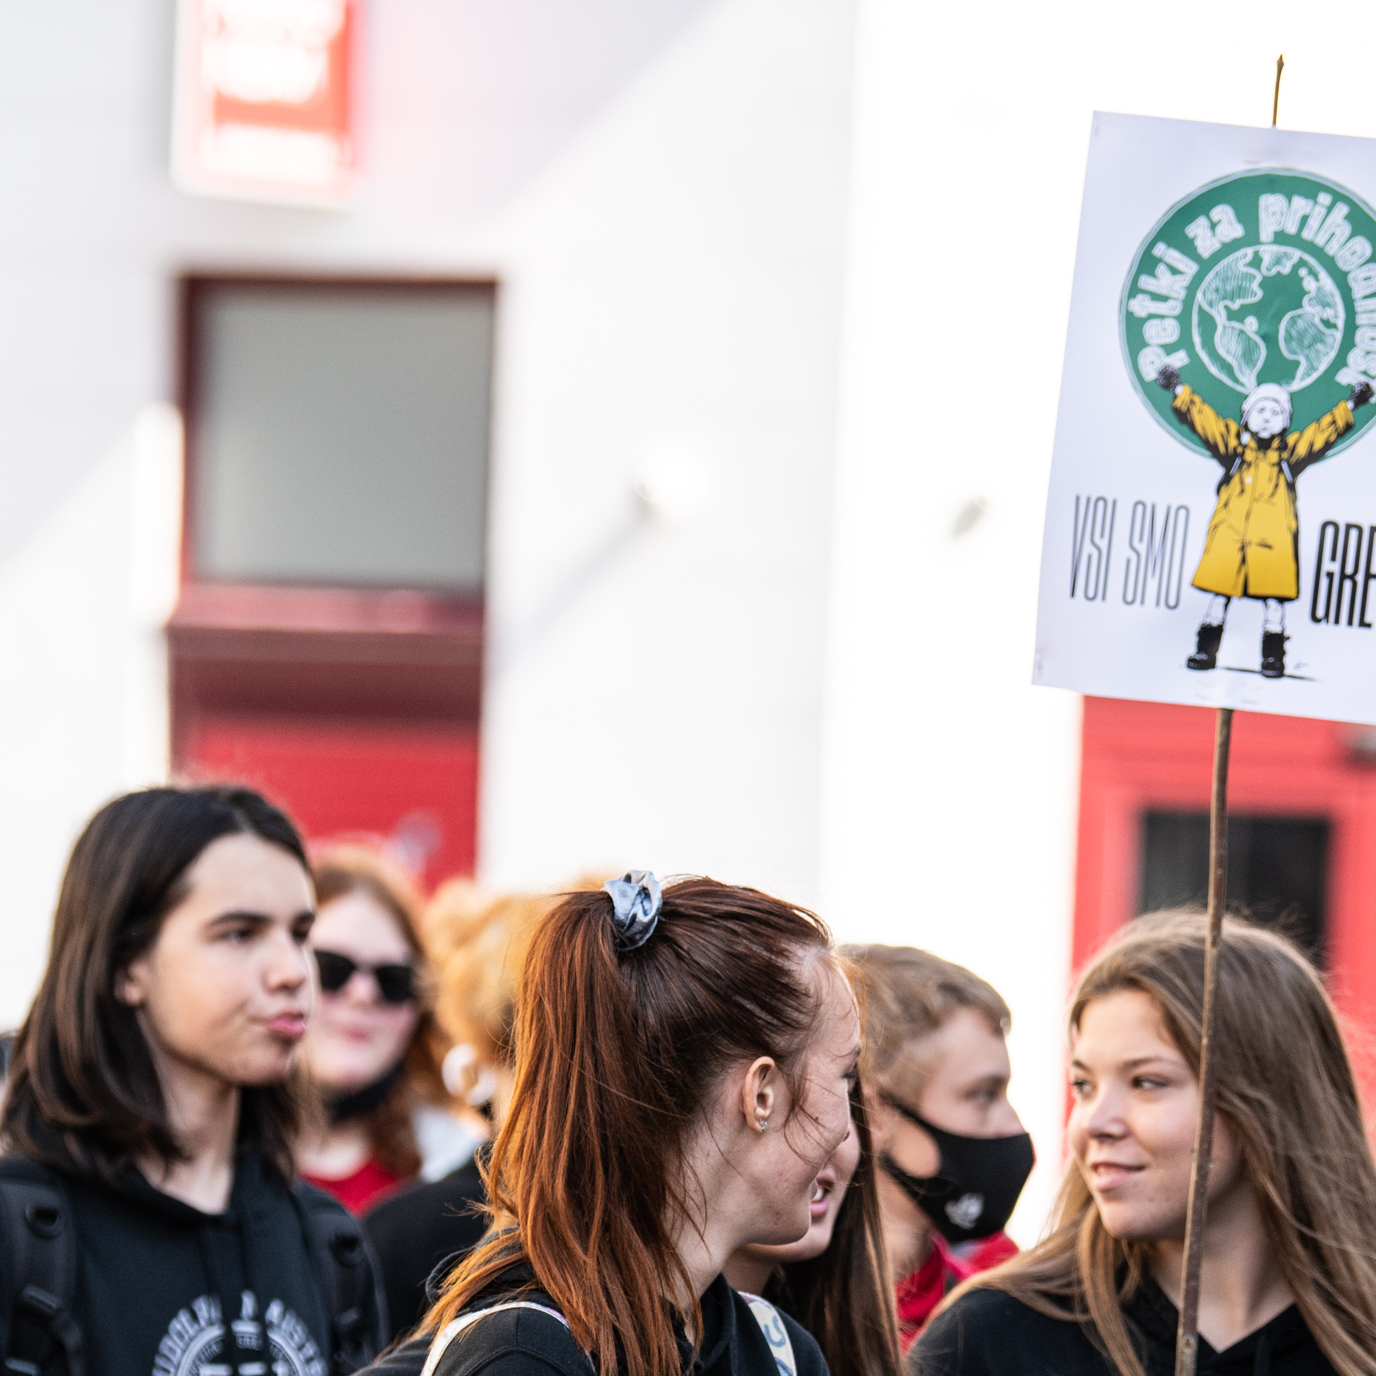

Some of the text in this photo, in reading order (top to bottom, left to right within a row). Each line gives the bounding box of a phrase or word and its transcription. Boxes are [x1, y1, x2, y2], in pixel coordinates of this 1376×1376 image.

[1127, 241, 1200, 382] Petki
[1184, 203, 1246, 260] za
[1071, 494, 1190, 611] VSI SMO
